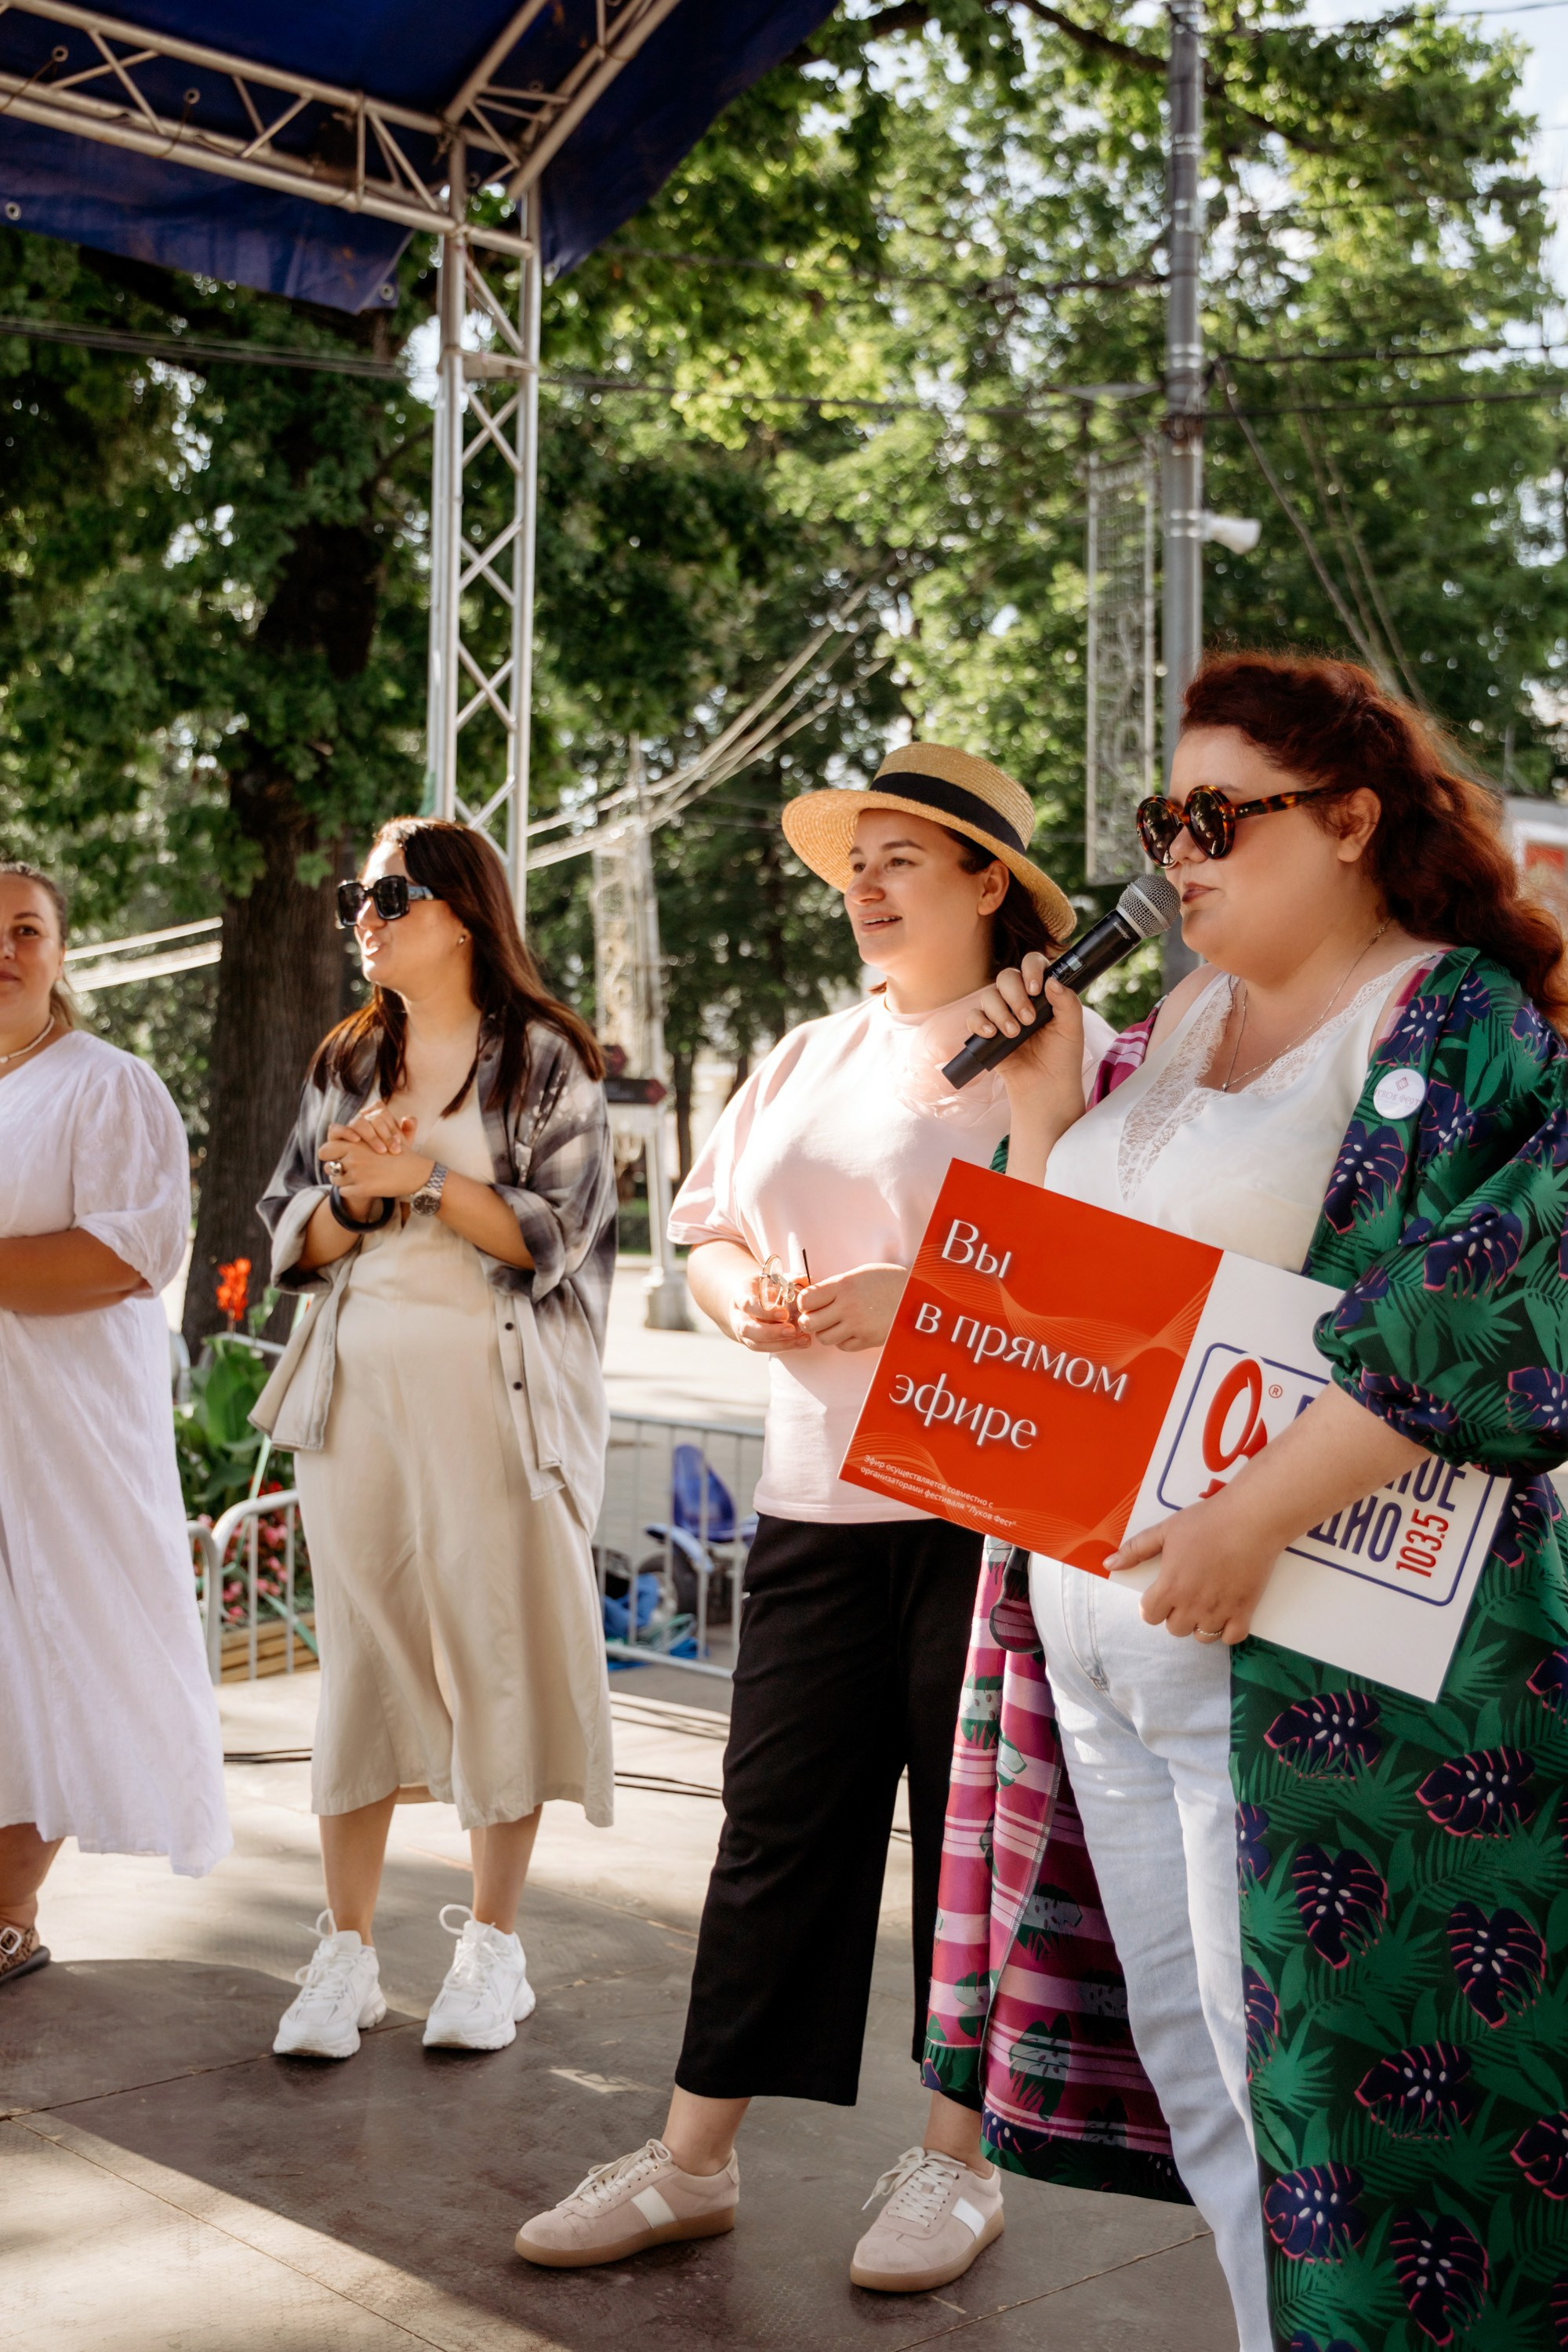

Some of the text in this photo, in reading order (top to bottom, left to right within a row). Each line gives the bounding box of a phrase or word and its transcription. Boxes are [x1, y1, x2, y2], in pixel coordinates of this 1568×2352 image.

[942, 1218, 1012, 1279] Вы
[914, 1302, 1128, 1402] в прямом
[888, 1373, 1038, 1450] эфире
[860, 1465, 1017, 1527] организаторами фестиваля "Луков Фест"
[864, 1454, 885, 1469] Эфир
[886, 1463, 946, 1491] осуществляется
[947, 1486, 987, 1507] совместно
[1395, 1508, 1450, 1577] 103.5
